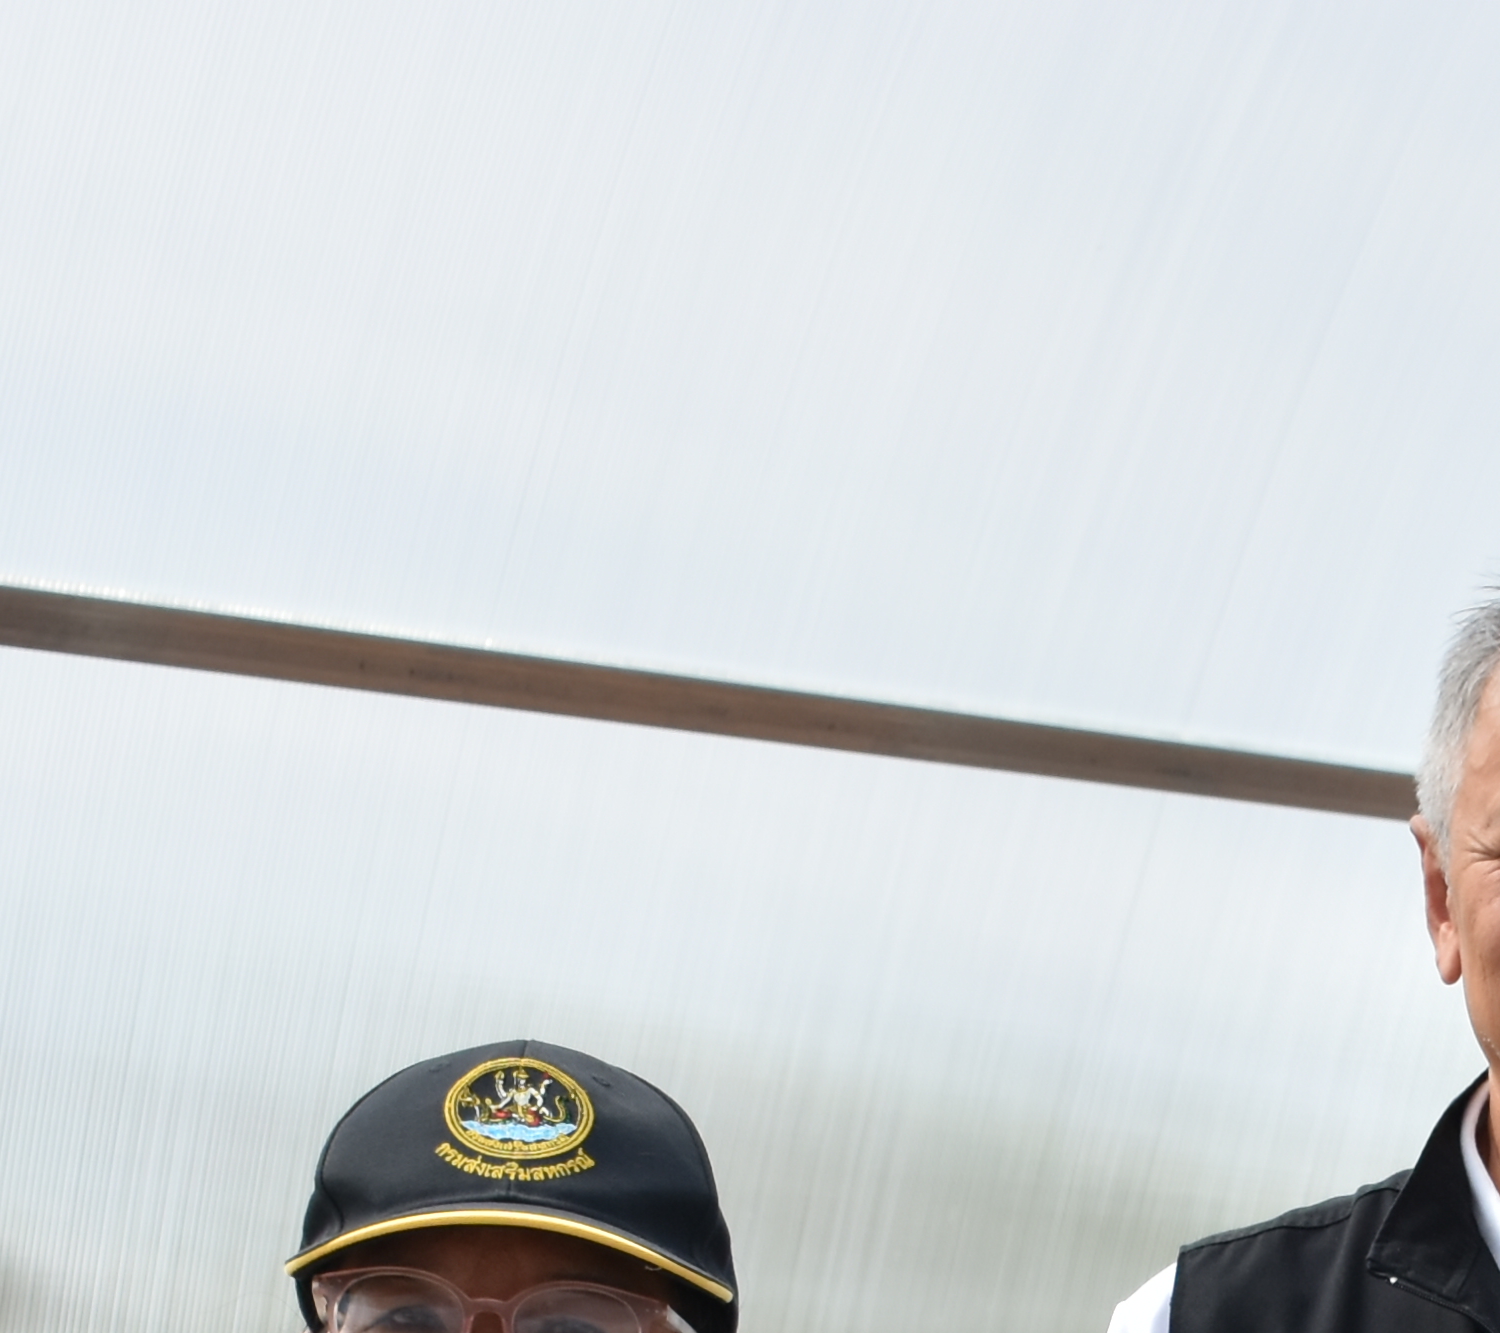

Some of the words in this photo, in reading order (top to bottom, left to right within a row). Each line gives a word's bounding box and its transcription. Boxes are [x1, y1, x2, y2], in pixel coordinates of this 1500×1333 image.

[434, 1141, 596, 1182] กรมส่งเสริมสหกรณ์
